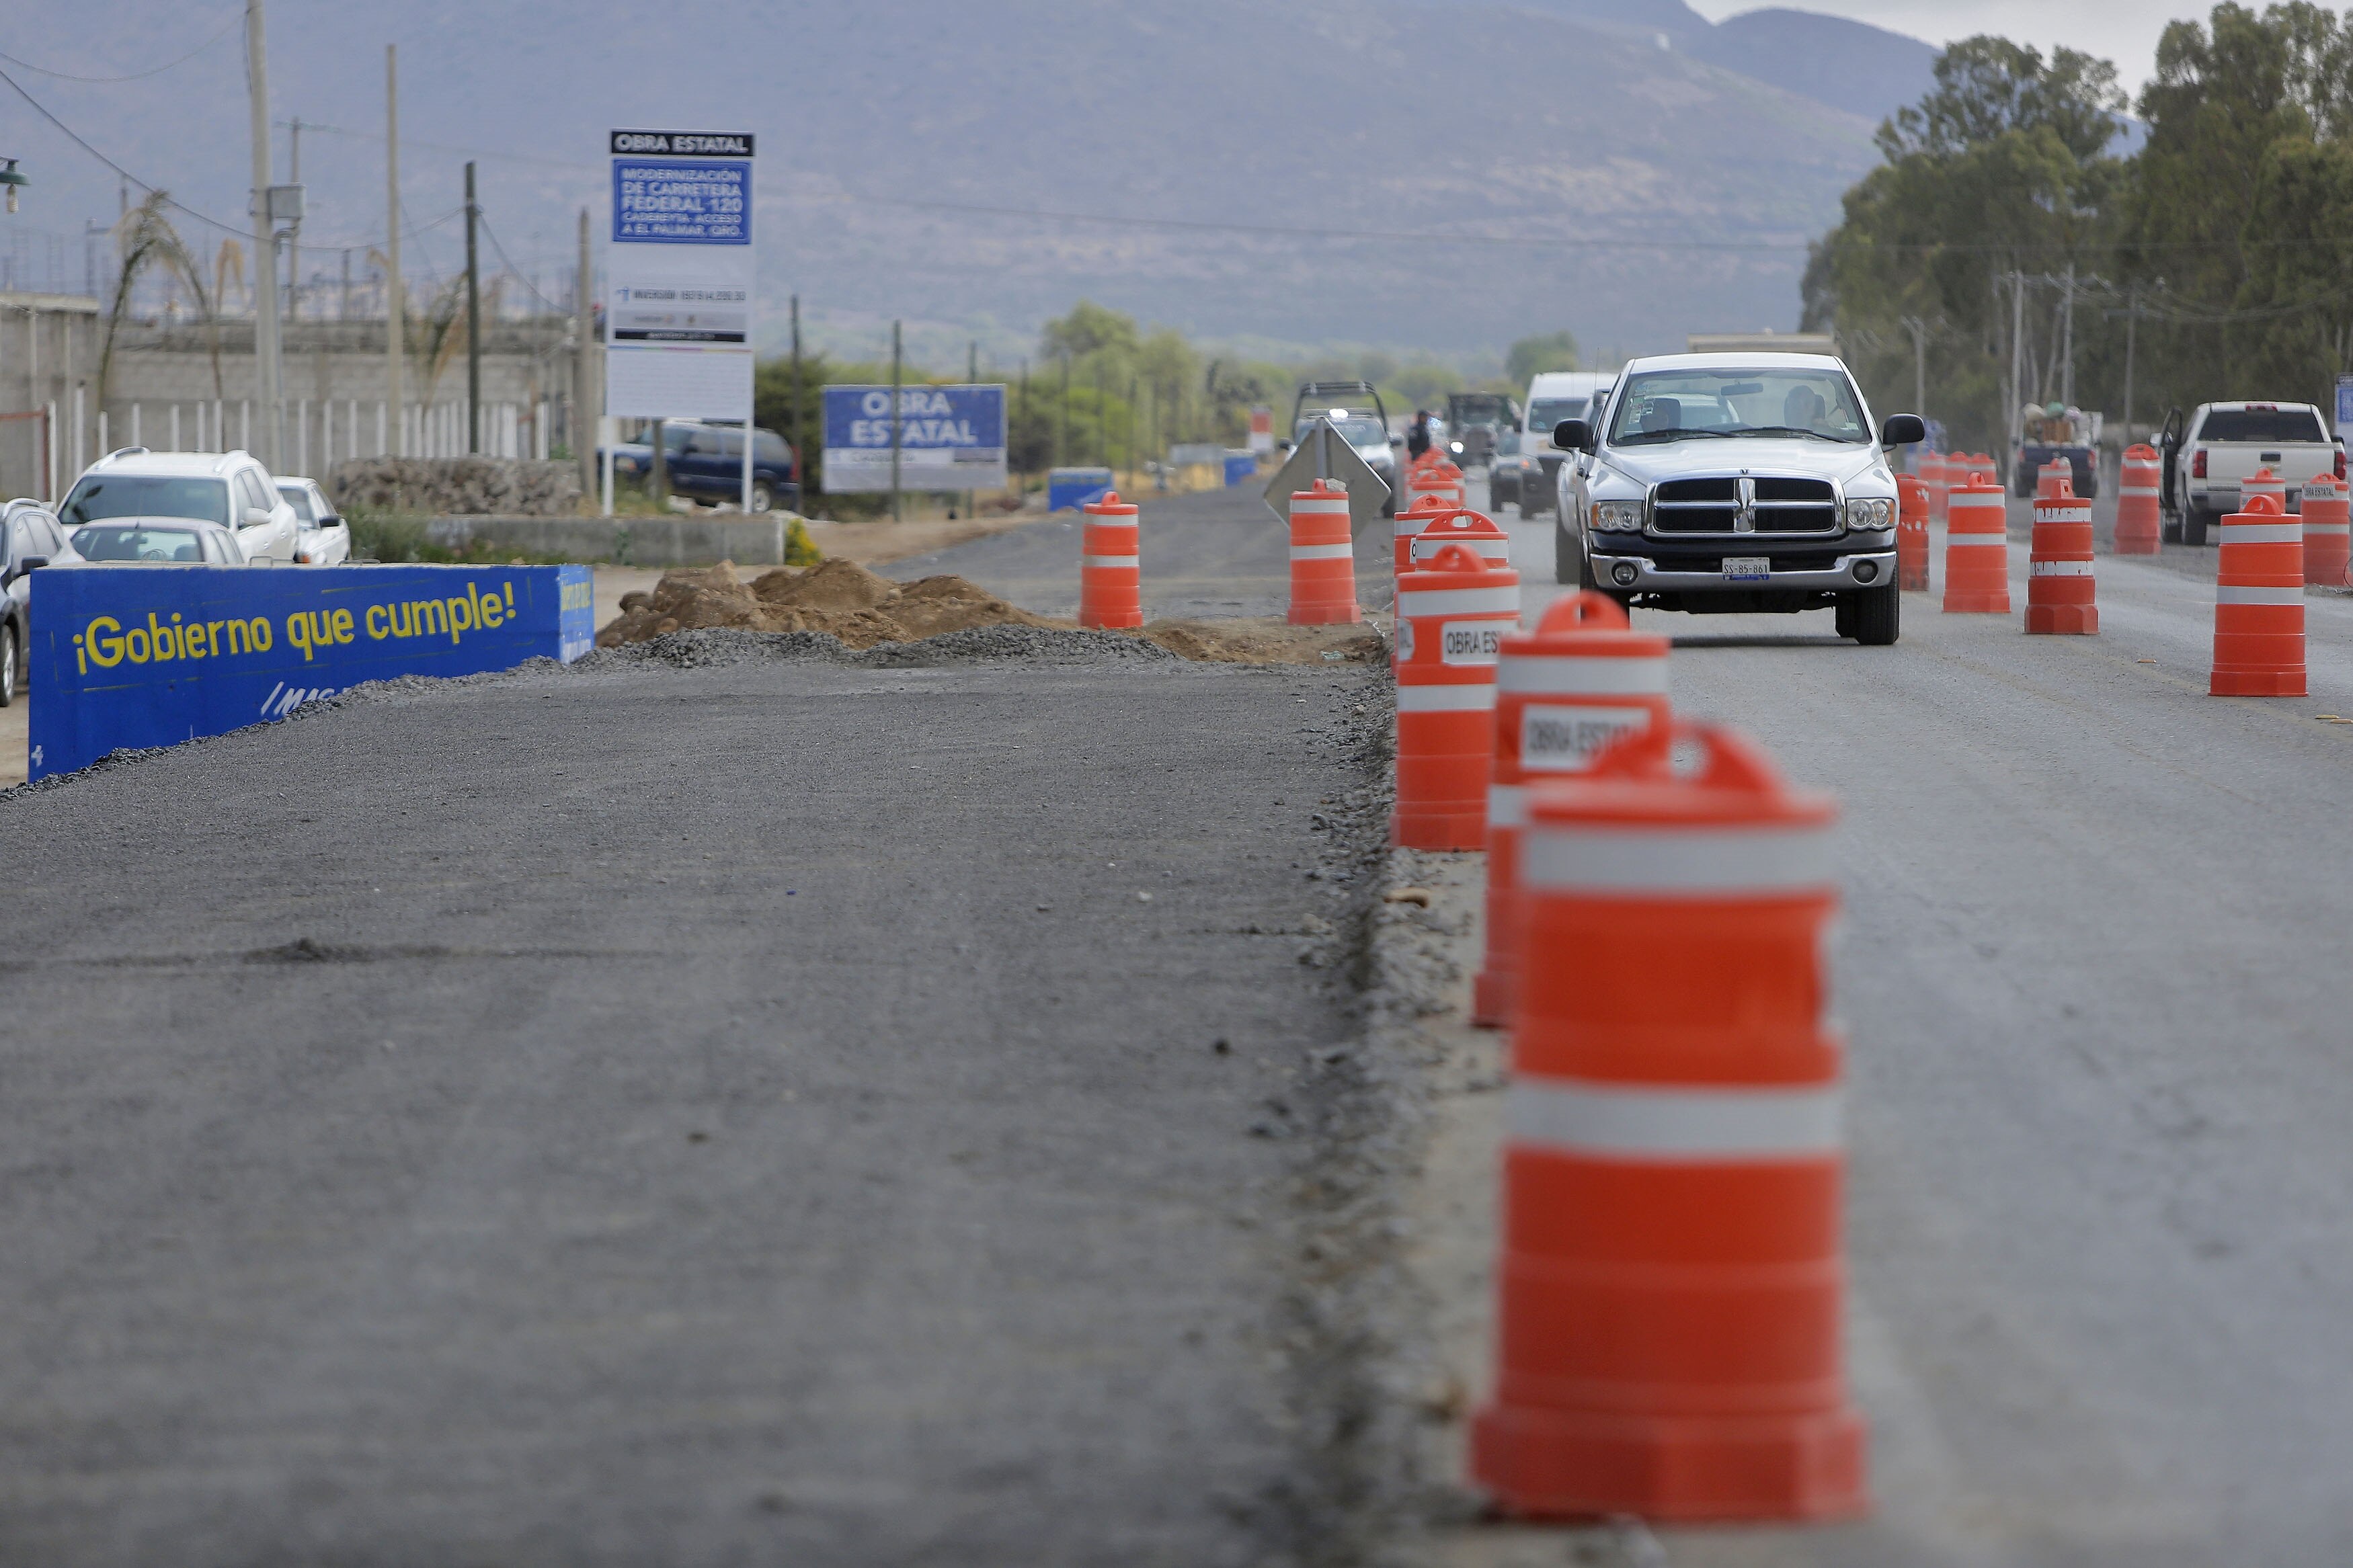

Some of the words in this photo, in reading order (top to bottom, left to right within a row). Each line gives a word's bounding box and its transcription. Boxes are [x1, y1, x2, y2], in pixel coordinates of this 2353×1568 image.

[614, 134, 670, 151] OBRA
[672, 136, 748, 153] ESTATAL
[622, 168, 742, 181] MODERNIZACIÓN
[623, 181, 645, 195] DE
[648, 182, 743, 196] CARRETERA
[622, 196, 705, 212] FEDERAL
[709, 198, 744, 212] 120
[622, 223, 633, 234] A
[635, 224, 650, 234] EL
[862, 391, 953, 417] OBRA
[1724, 564, 1767, 574] SS-85-861
[73, 612, 273, 675] ¡Gobierno
[286, 608, 355, 661] que
[366, 581, 517, 645] cumple!
[1446, 630, 1479, 654] OBRA
